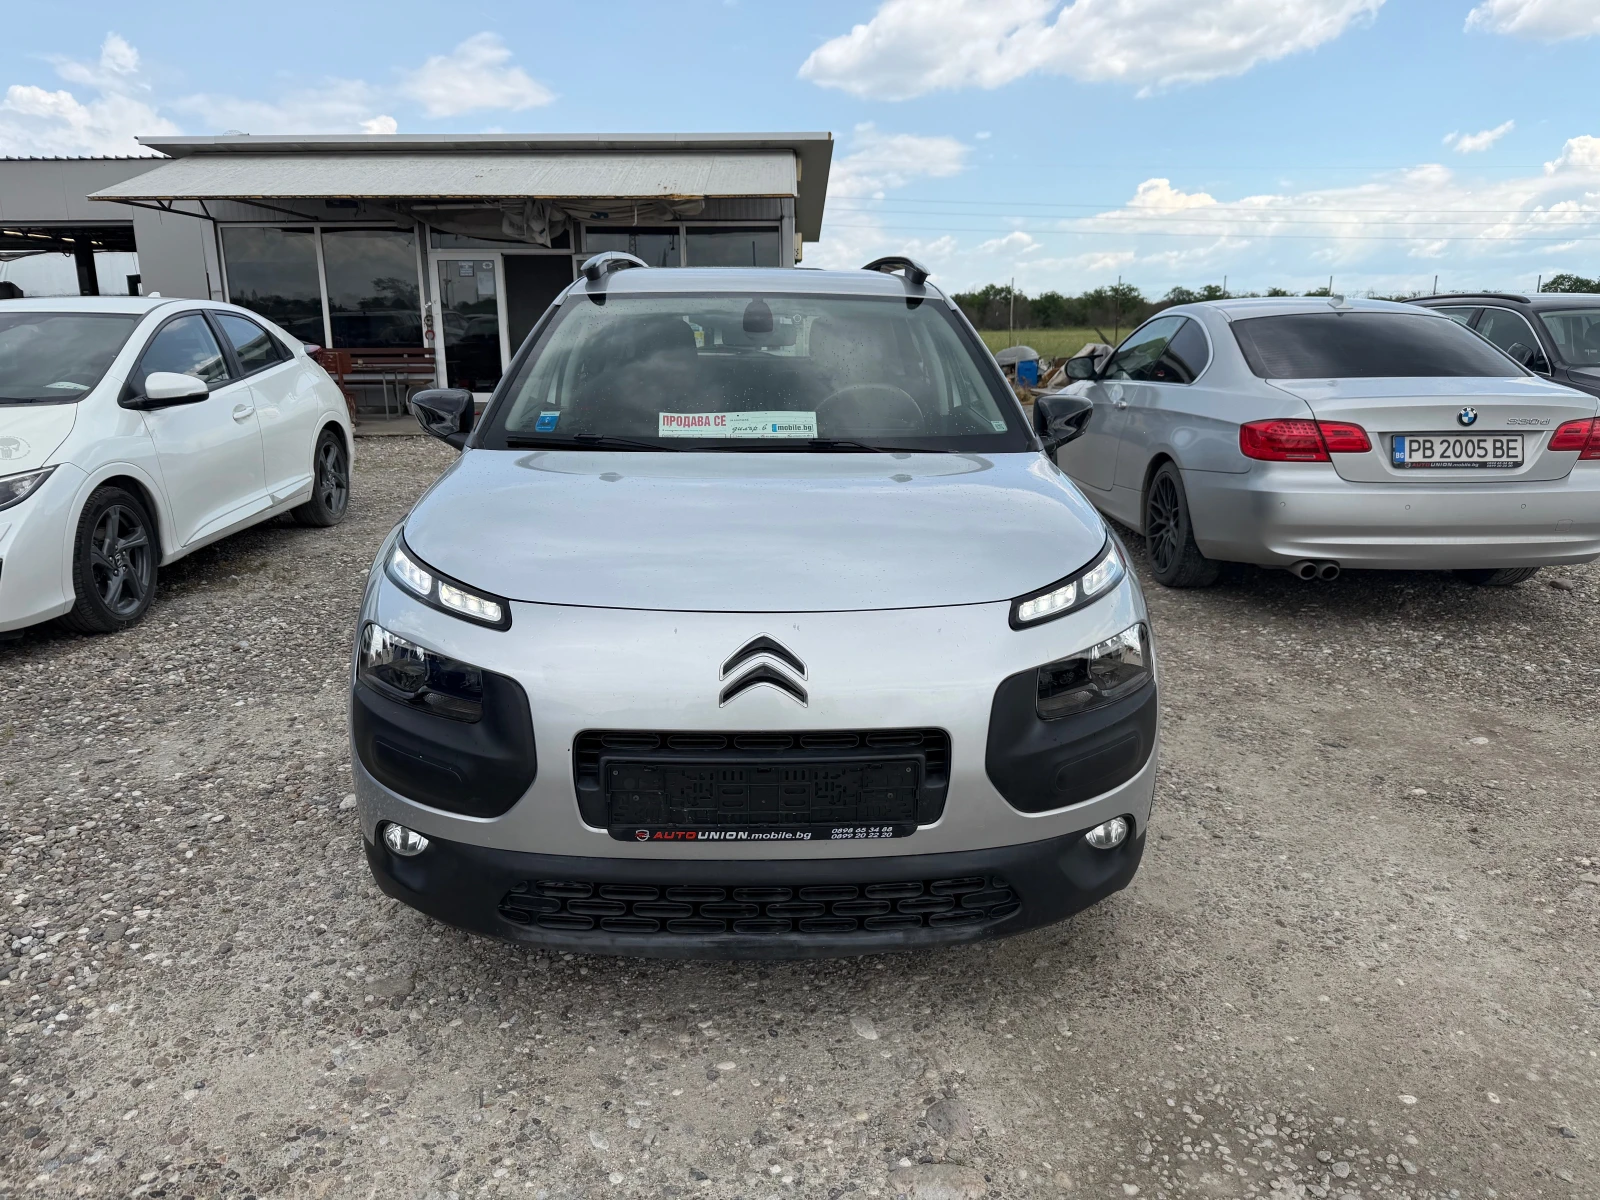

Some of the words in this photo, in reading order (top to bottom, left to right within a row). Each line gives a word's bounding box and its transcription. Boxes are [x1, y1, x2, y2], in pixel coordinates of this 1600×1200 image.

[662, 415, 711, 428] ПРОДАВА
[713, 415, 727, 427] СЕ
[777, 424, 812, 432] mobile.bg
[1439, 439, 1488, 458] 2005
